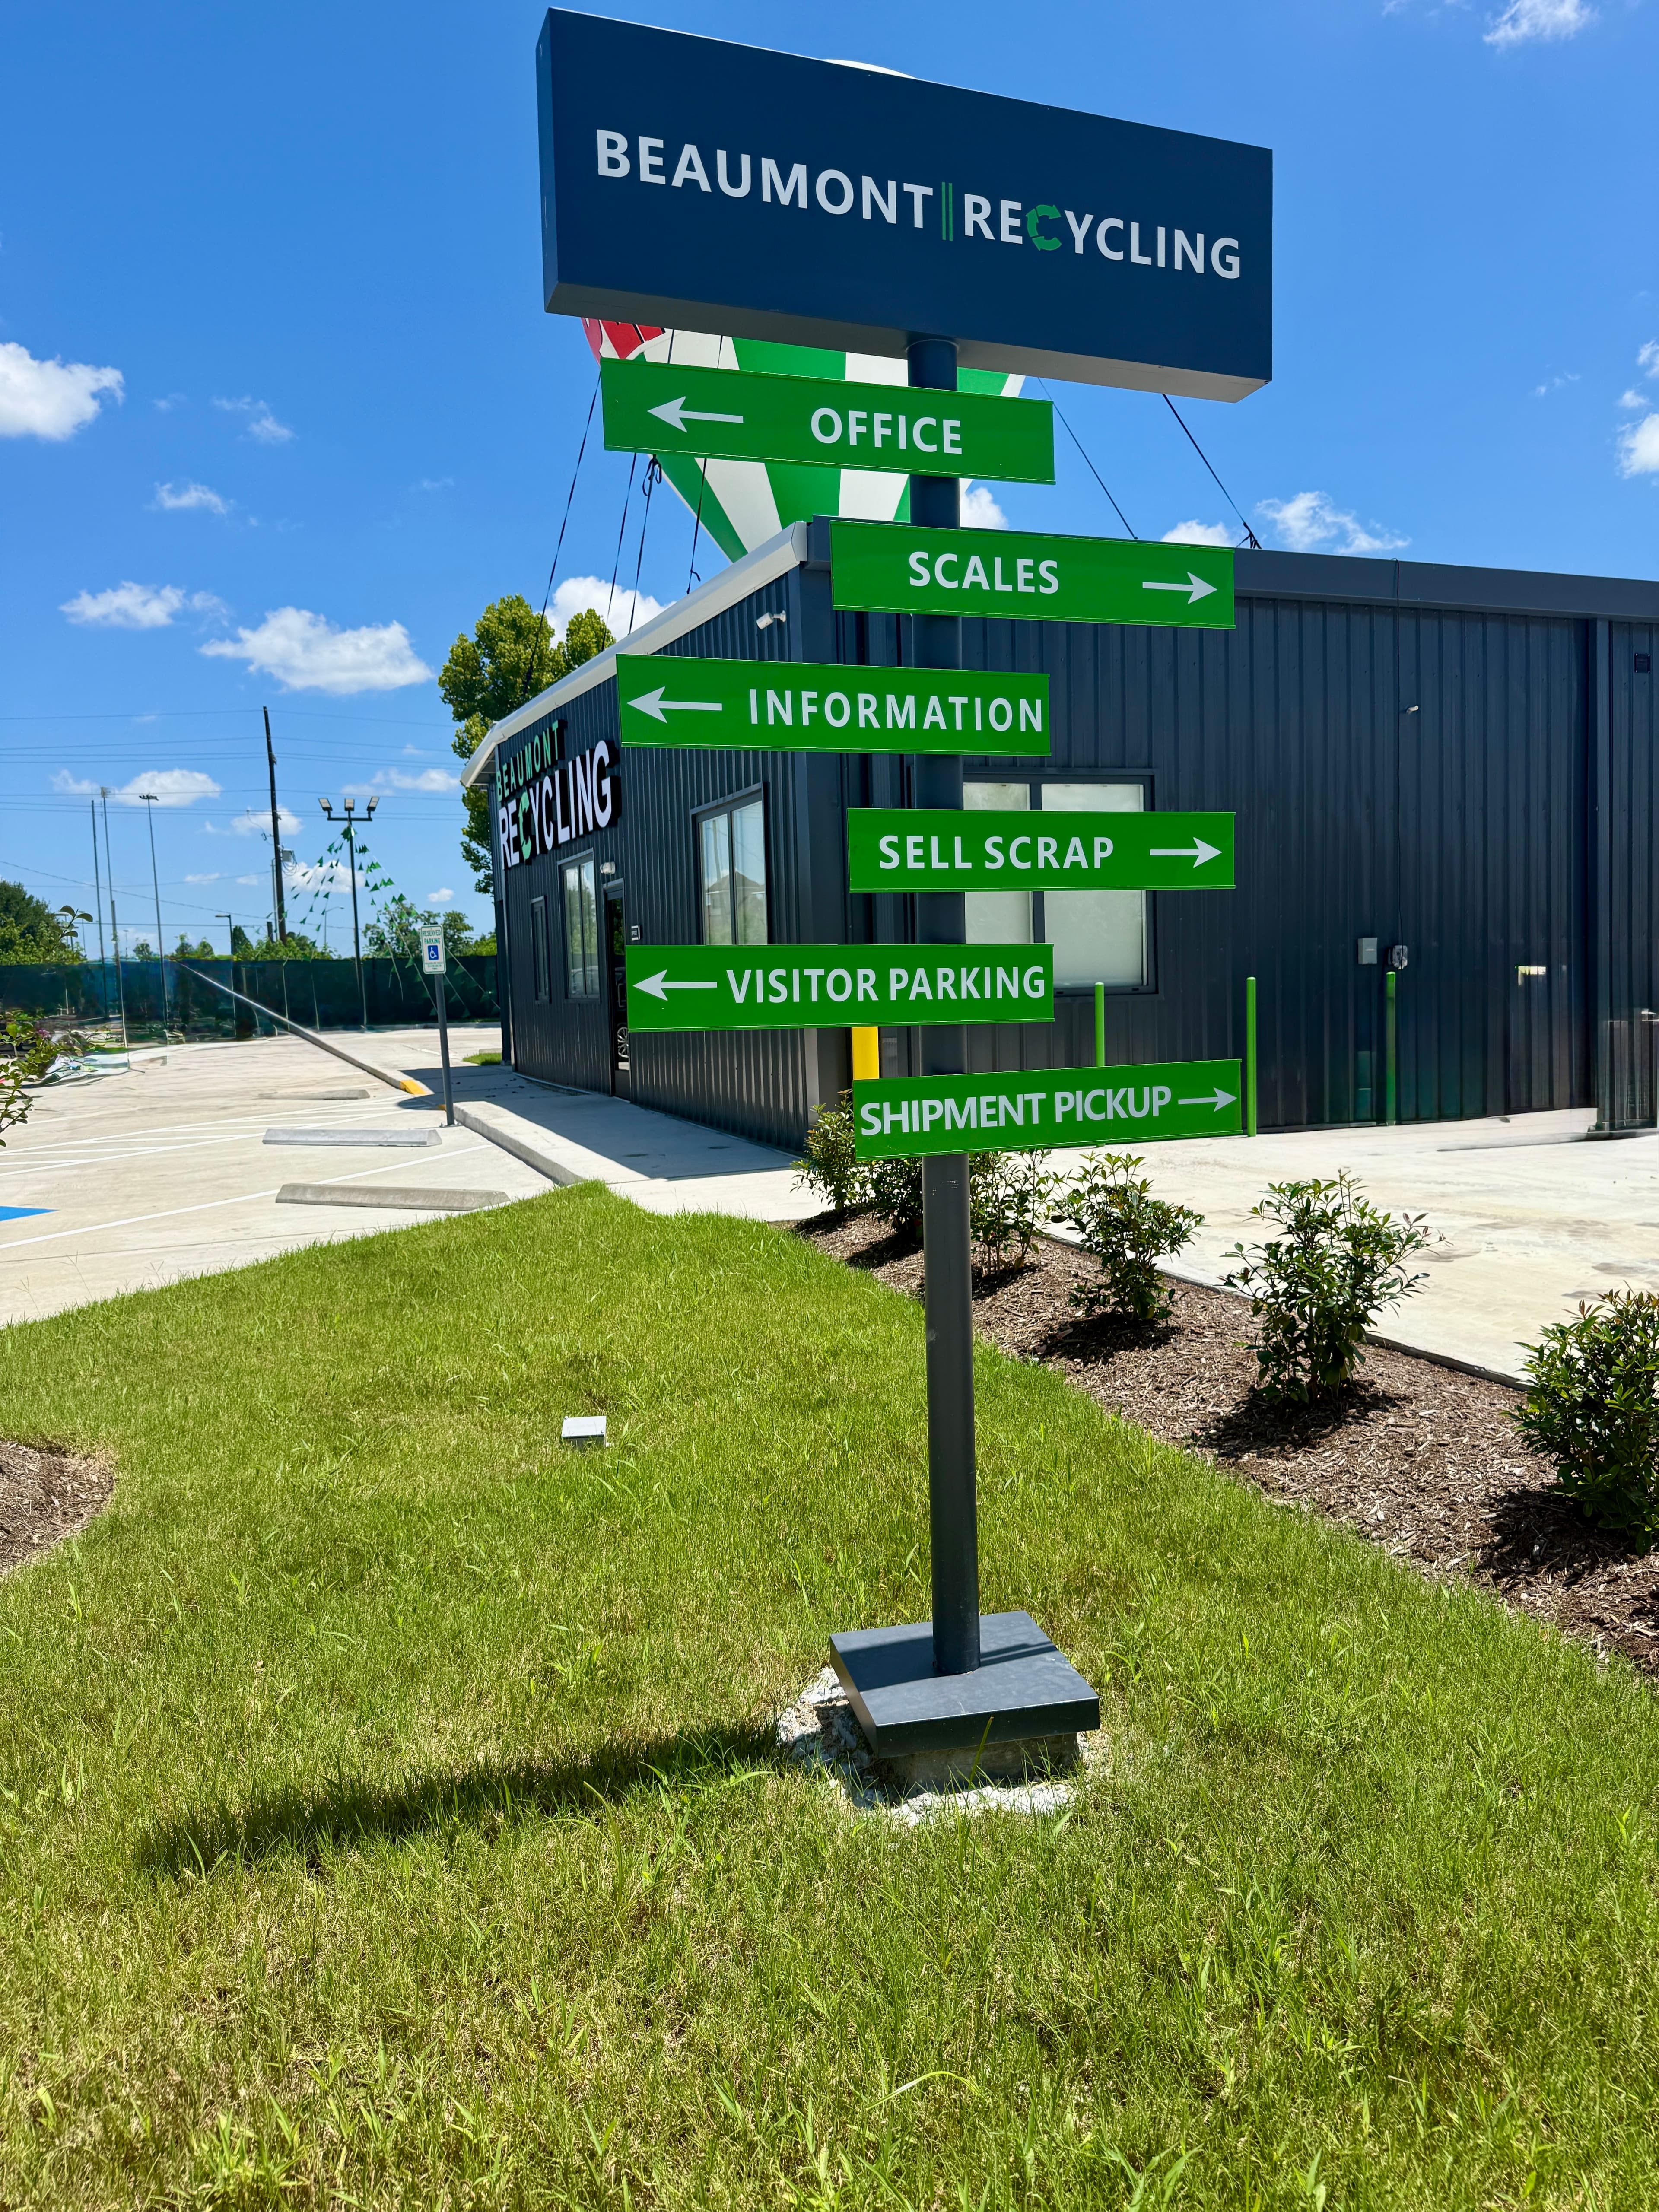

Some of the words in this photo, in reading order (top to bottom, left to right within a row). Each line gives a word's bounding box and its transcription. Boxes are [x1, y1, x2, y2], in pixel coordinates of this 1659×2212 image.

[597, 129, 933, 229] BEAUMONT
[964, 193, 1240, 279] RECYCLING
[811, 407, 962, 454] OFFICE
[909, 551, 1059, 594] SCALES
[750, 689, 1042, 732] INFORMATION
[497, 720, 558, 801] BEAUMONT
[499, 740, 612, 870] RECYCLING
[879, 835, 972, 869] SELL
[985, 836, 1113, 869] SCRAP
[726, 968, 879, 1003] VISITOR
[890, 966, 1045, 1001] PARKING
[861, 1093, 1046, 1135] SHIPMENT
[1055, 1086, 1171, 1122] PICKUP
